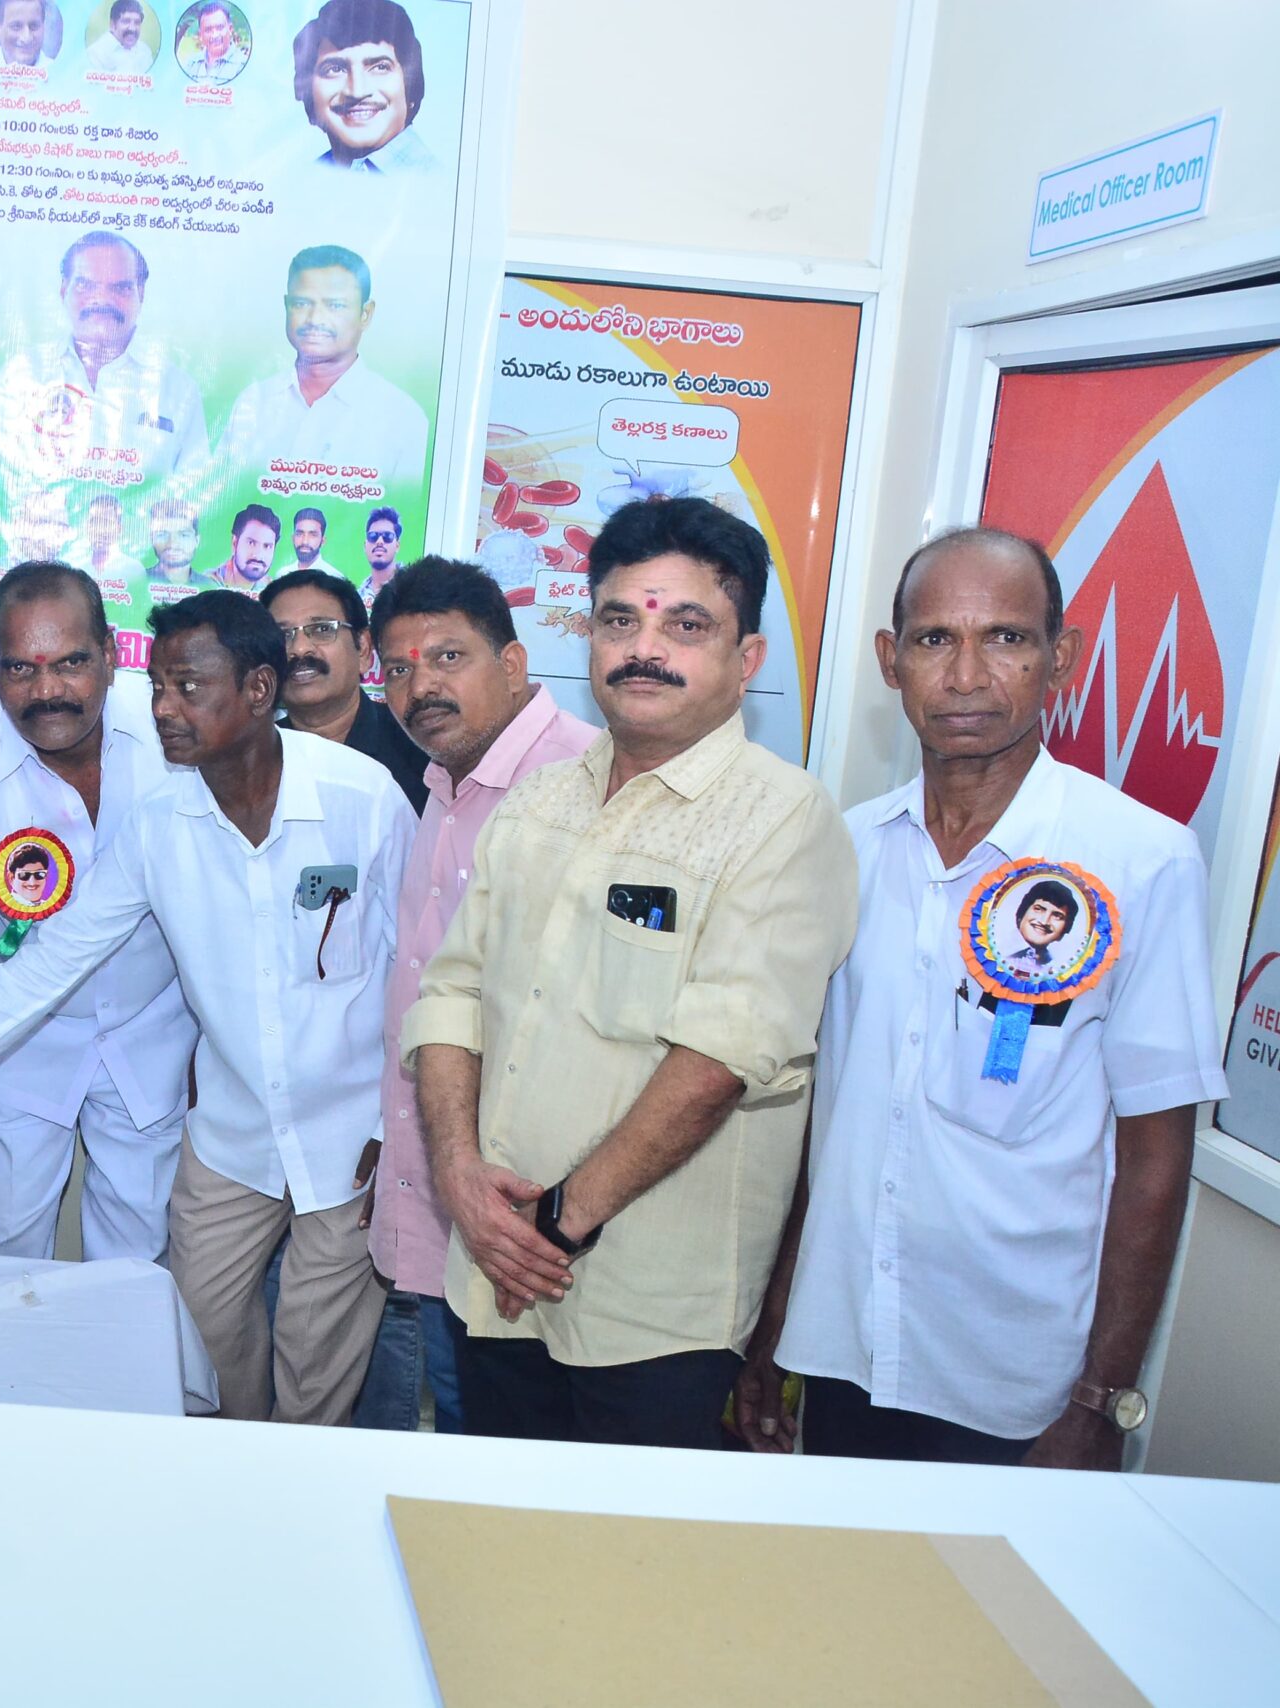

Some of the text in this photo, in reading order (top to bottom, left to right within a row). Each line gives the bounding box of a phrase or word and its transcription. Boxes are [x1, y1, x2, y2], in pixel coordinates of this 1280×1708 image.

[4, 120, 37, 133] 10:00
[84, 125, 99, 141] రక్త
[101, 127, 122, 139] దాన
[0, 165, 33, 177] 12:30
[101, 171, 132, 187] ఖమ్మం
[217, 179, 264, 194] అన్నదానం
[1038, 156, 1204, 227] Medical Officer Room
[182, 217, 240, 234] చేయబడును
[518, 306, 644, 339] అందులోని
[648, 316, 744, 346] భాగాలు
[501, 358, 770, 399] మూడు రకాలుగా ఉంటాయి
[611, 417, 728, 440] తెల్లరక్త కణాలు
[271, 459, 338, 475] మునగాల
[261, 478, 381, 499] ఖమ్మం నగర అధ్యక్షులు
[1246, 1038, 1280, 1072] GIV
